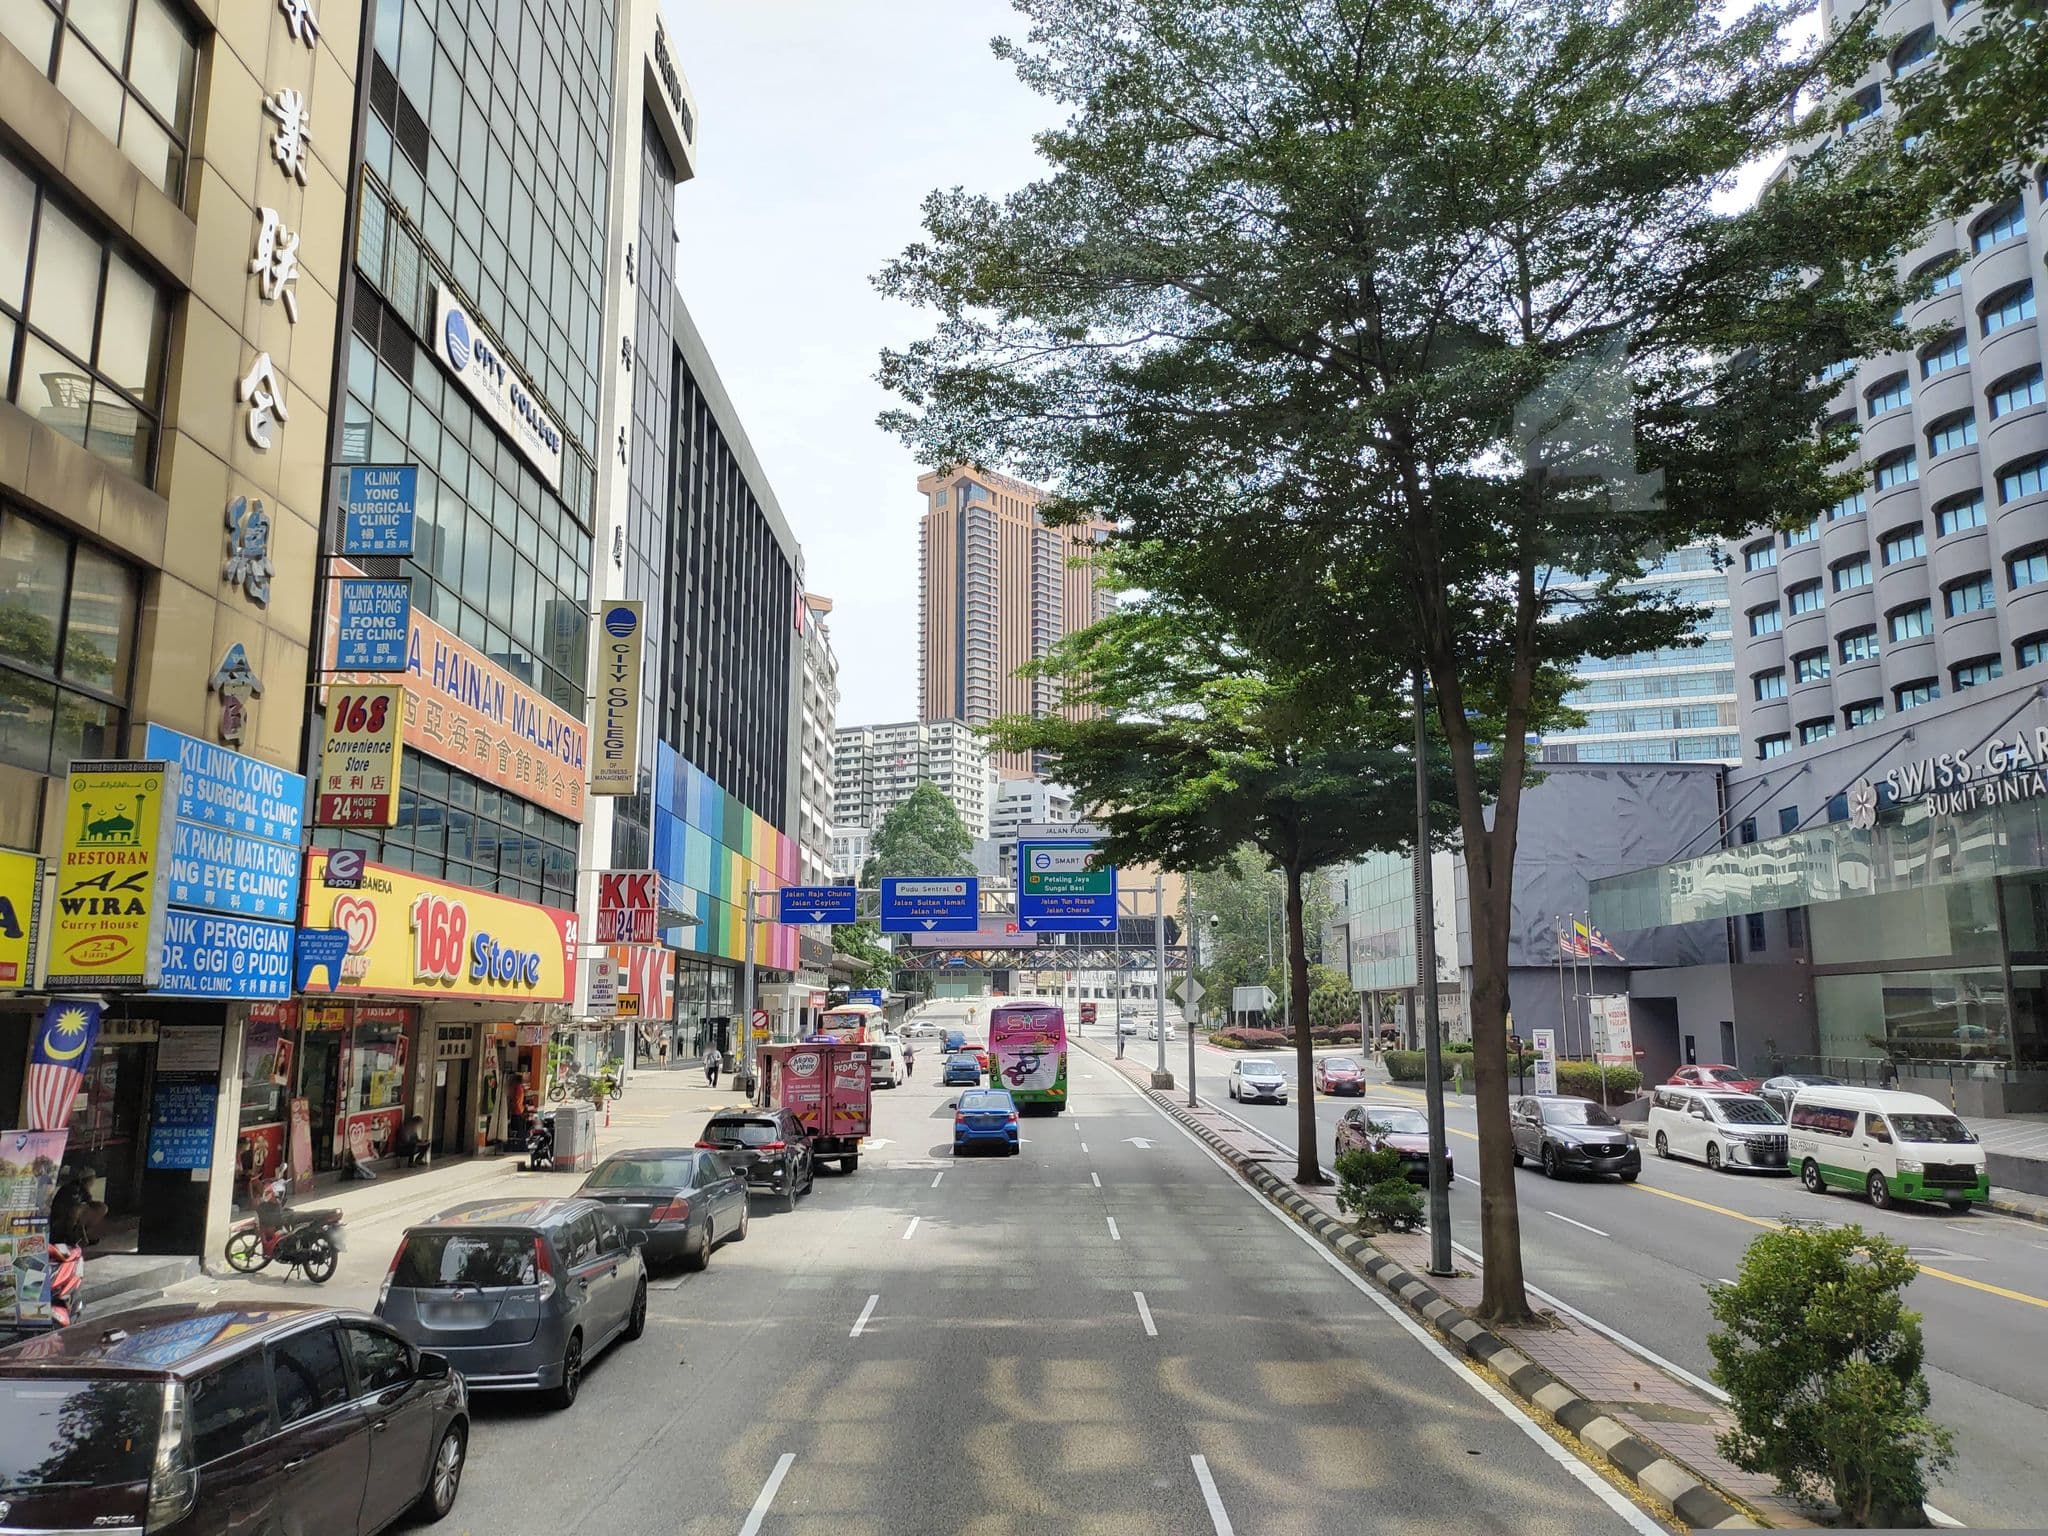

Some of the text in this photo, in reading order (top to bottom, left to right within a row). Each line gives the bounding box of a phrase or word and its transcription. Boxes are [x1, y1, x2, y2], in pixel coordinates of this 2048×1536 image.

[474, 338, 560, 455] CITY COLLEGE
[364, 471, 401, 486] KLINIK
[365, 488, 399, 500] YONG
[350, 502, 412, 514] SURGICAL
[359, 514, 400, 526] CLINIC
[344, 585, 408, 599] KLINIK PAKAR
[349, 600, 402, 614] MATA FONG
[350, 616, 397, 628] FONG
[341, 629, 405, 641] EYE CLINIC
[432, 640, 506, 726] HAINAN
[511, 691, 583, 772] MALAYSIA
[603, 643, 631, 760] CITY COLLEGE
[333, 695, 390, 734] 168
[326, 738, 392, 754] Convenience
[345, 756, 370, 772] Store
[243, 760, 284, 799] YONG
[328, 775, 386, 790] 便利店
[197, 778, 259, 816] SURGICAL
[261, 799, 298, 827] CLINIC
[1926, 773, 2047, 818] BUKIT BINTA
[332, 797, 352, 821] 24
[67, 851, 149, 866] RESTORAN
[191, 829, 233, 866] PAKAR
[233, 838, 265, 871] MATA
[266, 846, 296, 878] FONG
[203, 863, 236, 891] EYE
[239, 871, 288, 899] CLINIC
[1044, 876, 1072, 884] Petaling
[1074, 876, 1090, 884] Jaya
[601, 873, 653, 909] KK
[1044, 885, 1068, 893] Sungai
[59, 897, 147, 916] WIRA
[814, 899, 840, 907] Ceylon
[61, 920, 139, 931] Curry House
[565, 919, 578, 944] 24
[617, 910, 633, 942] 24
[634, 911, 653, 940] JAM
[203, 920, 289, 953] PERGIGIAN
[413, 893, 541, 985] 168 Store
[92, 942, 116, 952] 24
[193, 948, 228, 973] GIGI
[231, 950, 245, 974] @
[249, 952, 289, 977] PUDU
[200, 975, 232, 992] CLINIC
[628, 946, 667, 1019] KK
[833, 1062, 858, 1073] PEDAS
